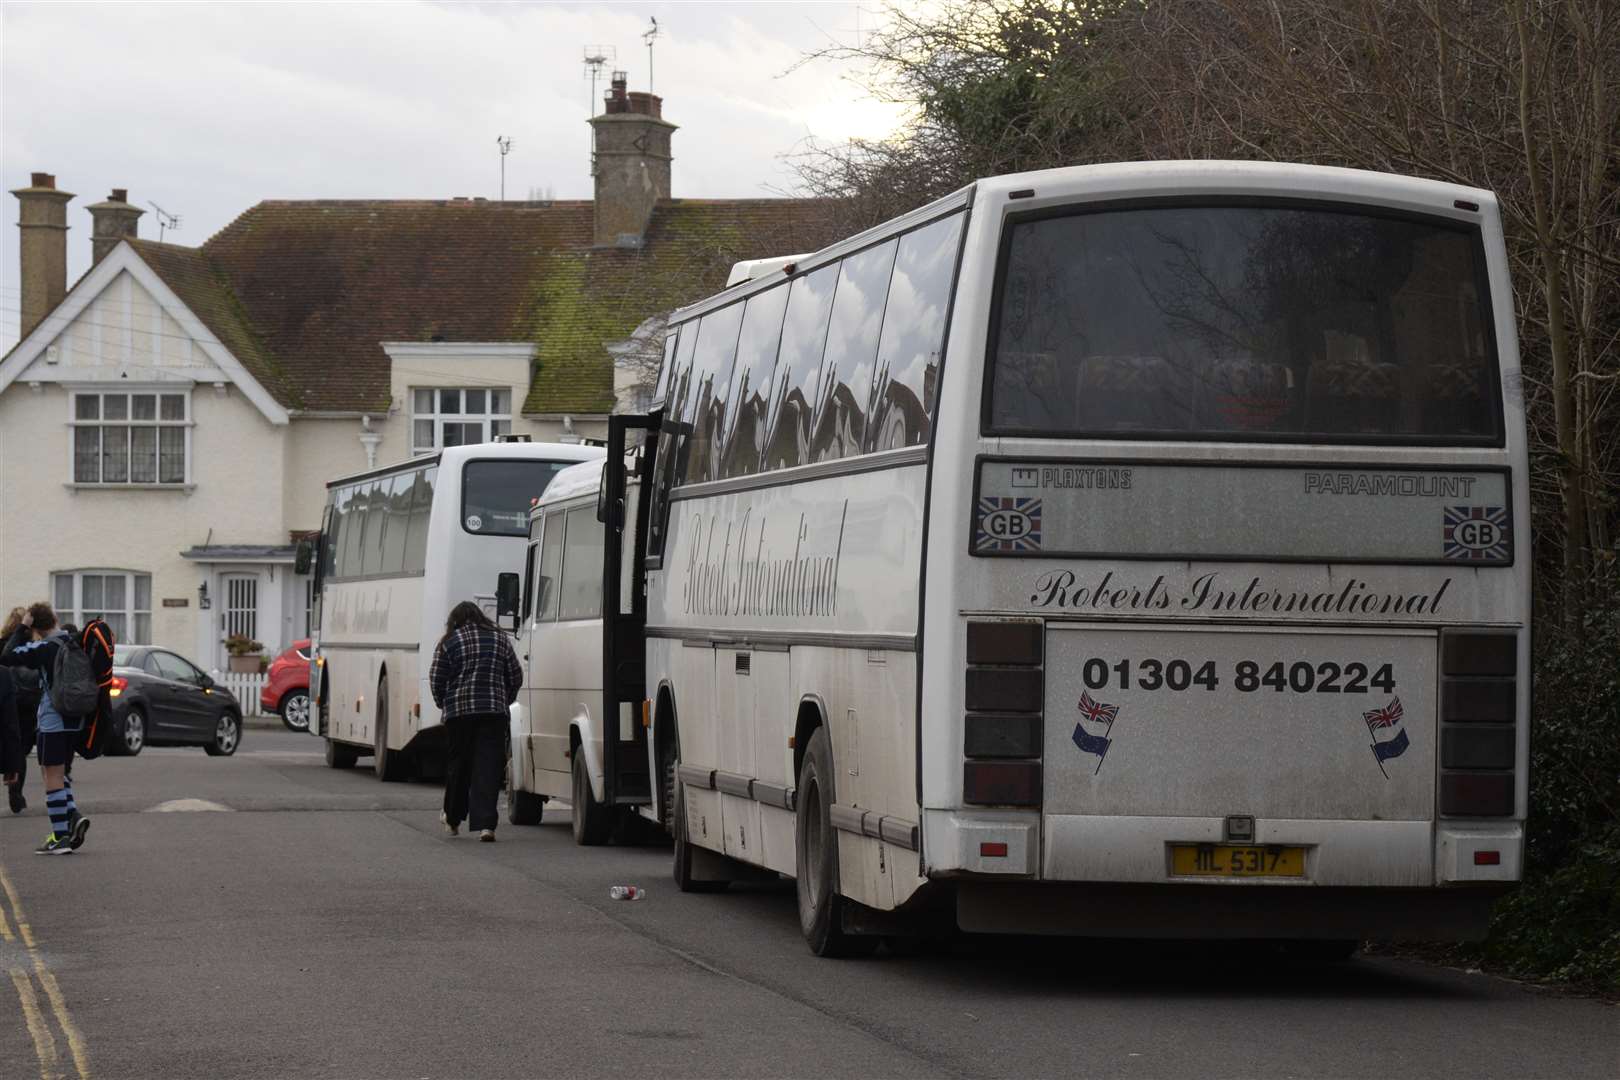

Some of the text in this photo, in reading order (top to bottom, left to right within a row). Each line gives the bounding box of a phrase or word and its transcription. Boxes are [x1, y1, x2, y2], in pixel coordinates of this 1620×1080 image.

[1042, 468, 1132, 489] PLAXTONS
[1304, 472, 1477, 498] PARAMOUNT
[467, 519, 482, 527] 100
[990, 514, 1024, 536] GB
[1461, 524, 1493, 545] GB
[1030, 568, 1452, 615] Roberts International
[1082, 658, 1396, 694] 01304 840224
[1231, 848, 1280, 872] 5317
